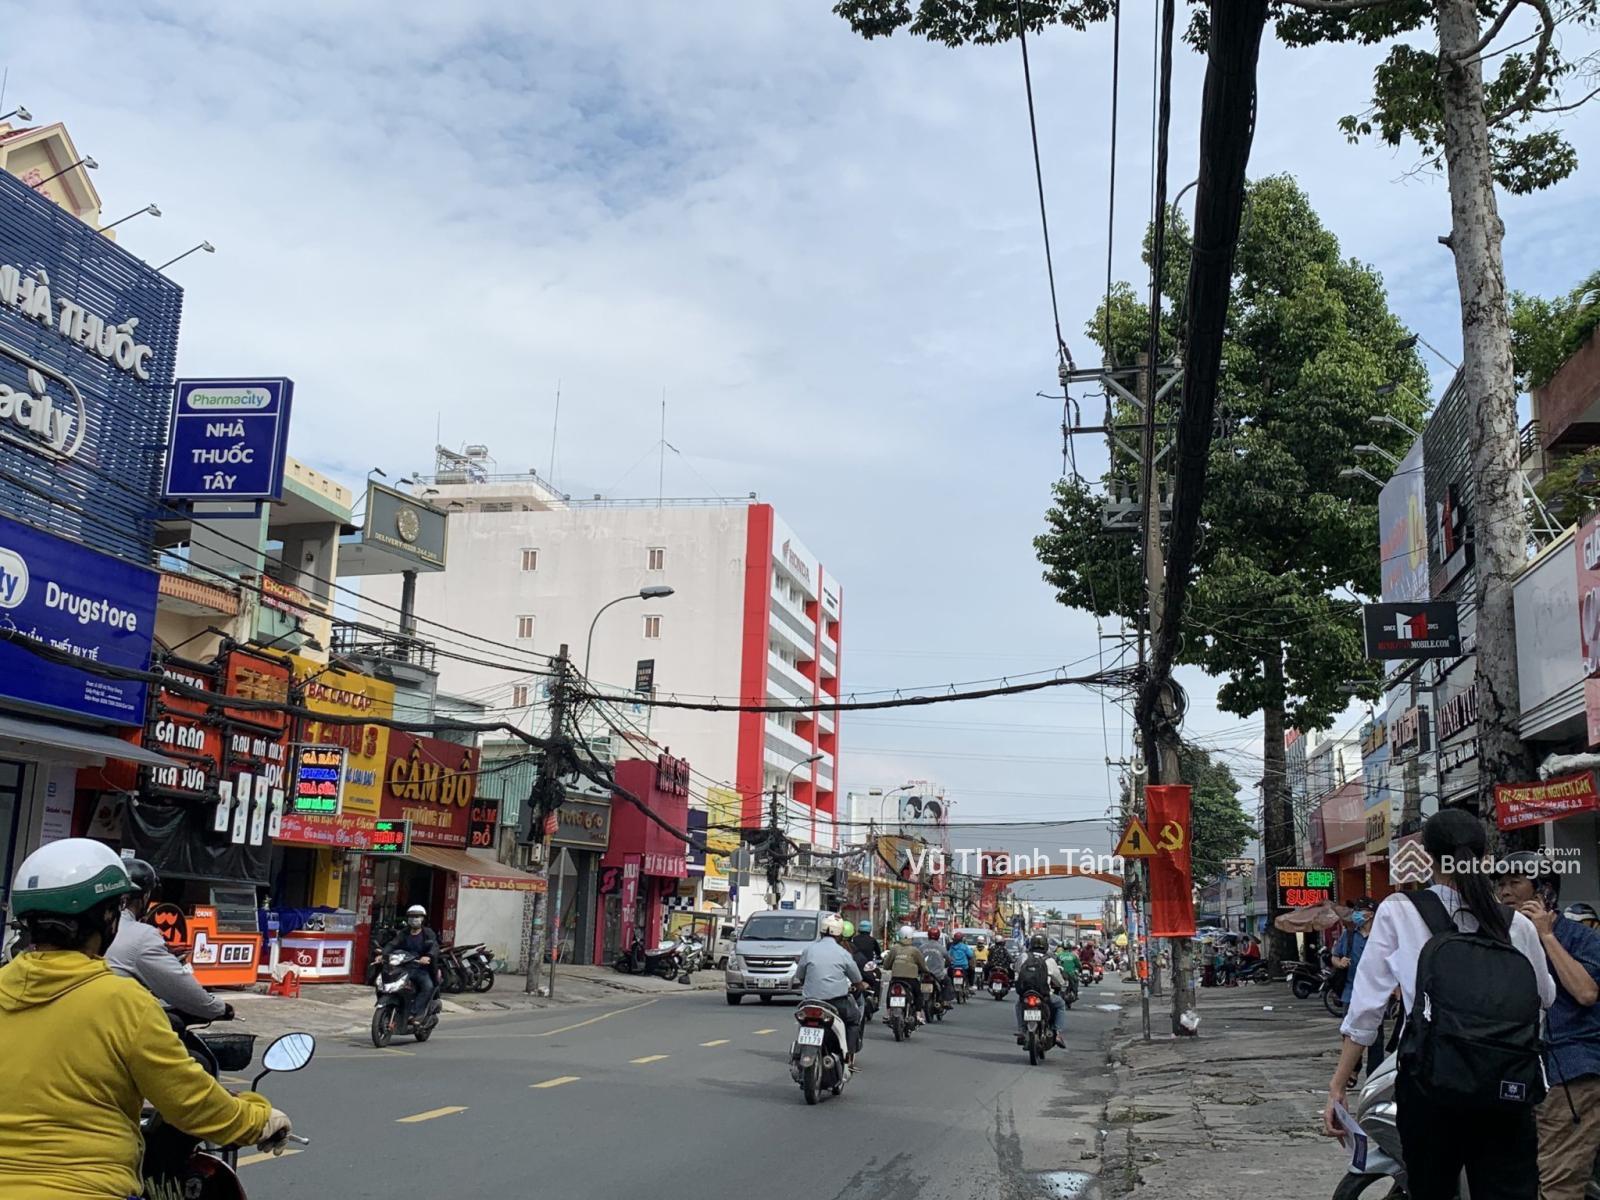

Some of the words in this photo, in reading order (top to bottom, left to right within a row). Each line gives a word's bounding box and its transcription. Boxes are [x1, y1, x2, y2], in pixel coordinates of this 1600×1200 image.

[58, 298, 152, 380] THUỐC
[193, 390, 264, 407] Pharmacity
[206, 420, 245, 438] NHÀ
[192, 442, 253, 464] THUỐC
[203, 473, 237, 490] TÂY
[45, 581, 137, 632] Drugstore
[155, 718, 175, 744] GÀ
[177, 722, 205, 750] RÁN
[232, 734, 250, 753] RAU
[253, 736, 267, 757] MÁ
[391, 738, 440, 802] CẦM
[440, 749, 472, 807] ĐỒ
[1279, 871, 1305, 887] BABY
[1306, 870, 1333, 887] SHOP
[1286, 888, 1329, 906] SUSU
